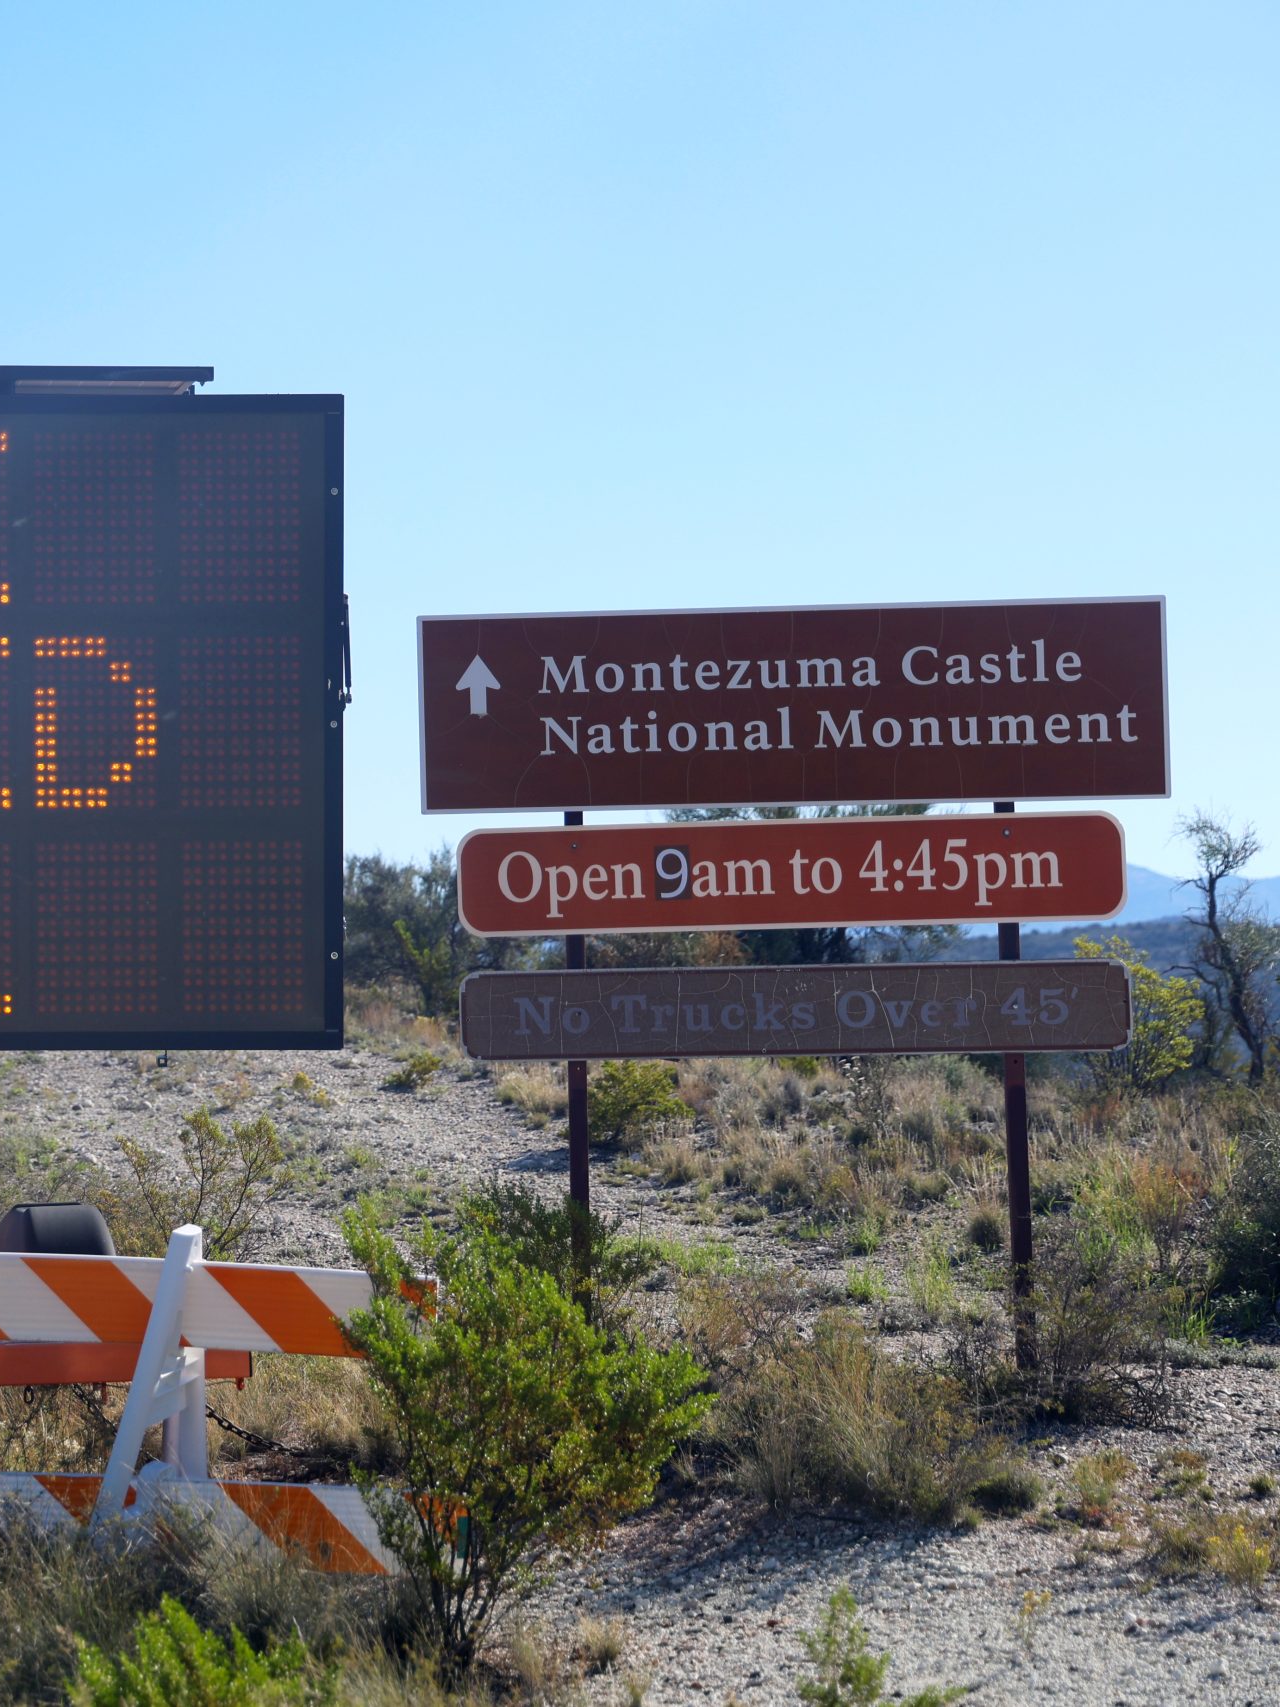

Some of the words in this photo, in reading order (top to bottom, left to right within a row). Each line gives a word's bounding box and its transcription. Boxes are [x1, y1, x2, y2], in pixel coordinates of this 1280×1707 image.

[538, 655, 881, 695] Montezuma
[901, 639, 1083, 686] Castle
[539, 706, 795, 756] National
[816, 704, 1139, 750] Monument
[498, 851, 645, 918] Open
[656, 848, 776, 900] 9am
[790, 849, 843, 895] to
[858, 838, 1063, 907] 4:45pm
[516, 997, 590, 1036] No
[610, 992, 816, 1034] Trucks
[837, 989, 980, 1030] Over
